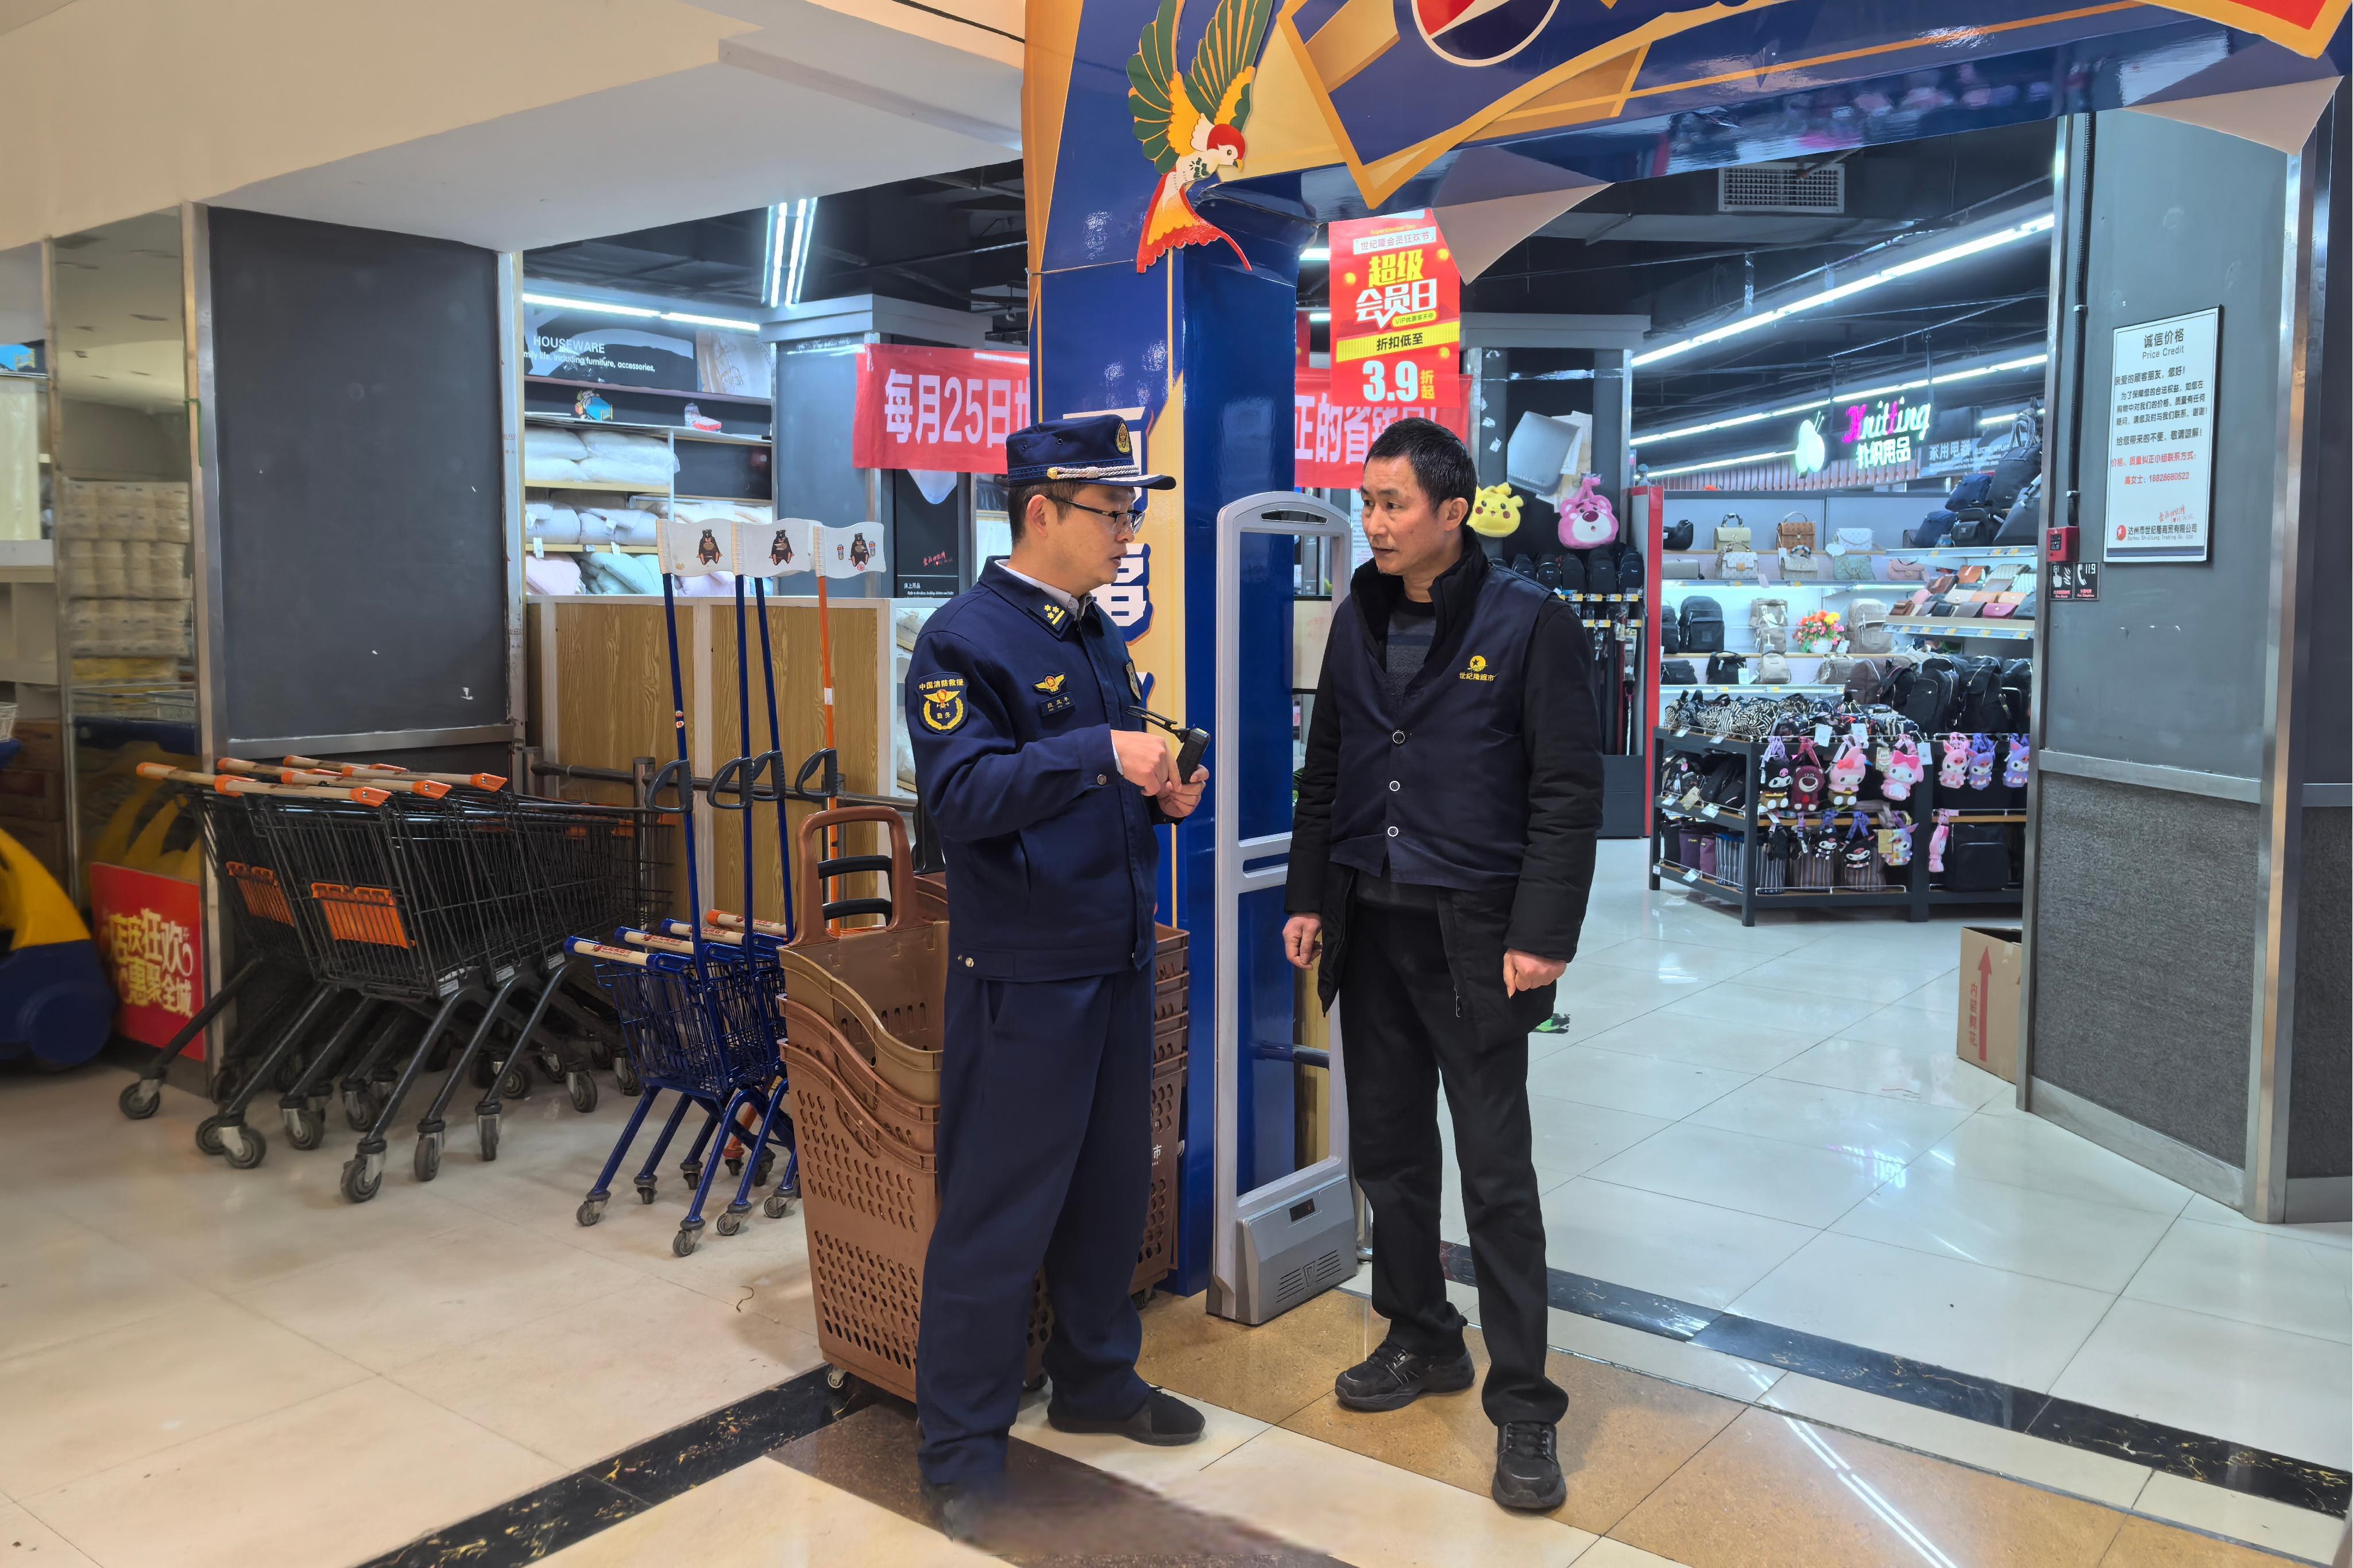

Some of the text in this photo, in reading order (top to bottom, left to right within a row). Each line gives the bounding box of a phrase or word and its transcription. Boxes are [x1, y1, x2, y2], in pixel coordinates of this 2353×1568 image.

[1369, 249, 1424, 288] 超级
[1355, 278, 1438, 329] 会员日
[534, 335, 605, 354] HOUSEWARE
[1377, 332, 1423, 351] 折扣低至
[2144, 328, 2184, 349] 诚信价格
[2142, 346, 2184, 361] Price Credit
[586, 356, 616, 368] furniture,
[617, 361, 655, 372] accessories,
[1363, 360, 1418, 402] 3.9
[1420, 369, 1435, 400] 折起
[1844, 396, 1931, 444] Knitting
[1856, 436, 1911, 469] 针织用品
[1929, 438, 1971, 461] 家用电器
[2128, 523, 2197, 535] 达州市世纪隆商贸有限公司
[2085, 563, 2096, 574] 119
[919, 678, 964, 691] 中国消防救援
[1459, 672, 1495, 682] 世纪隆超市
